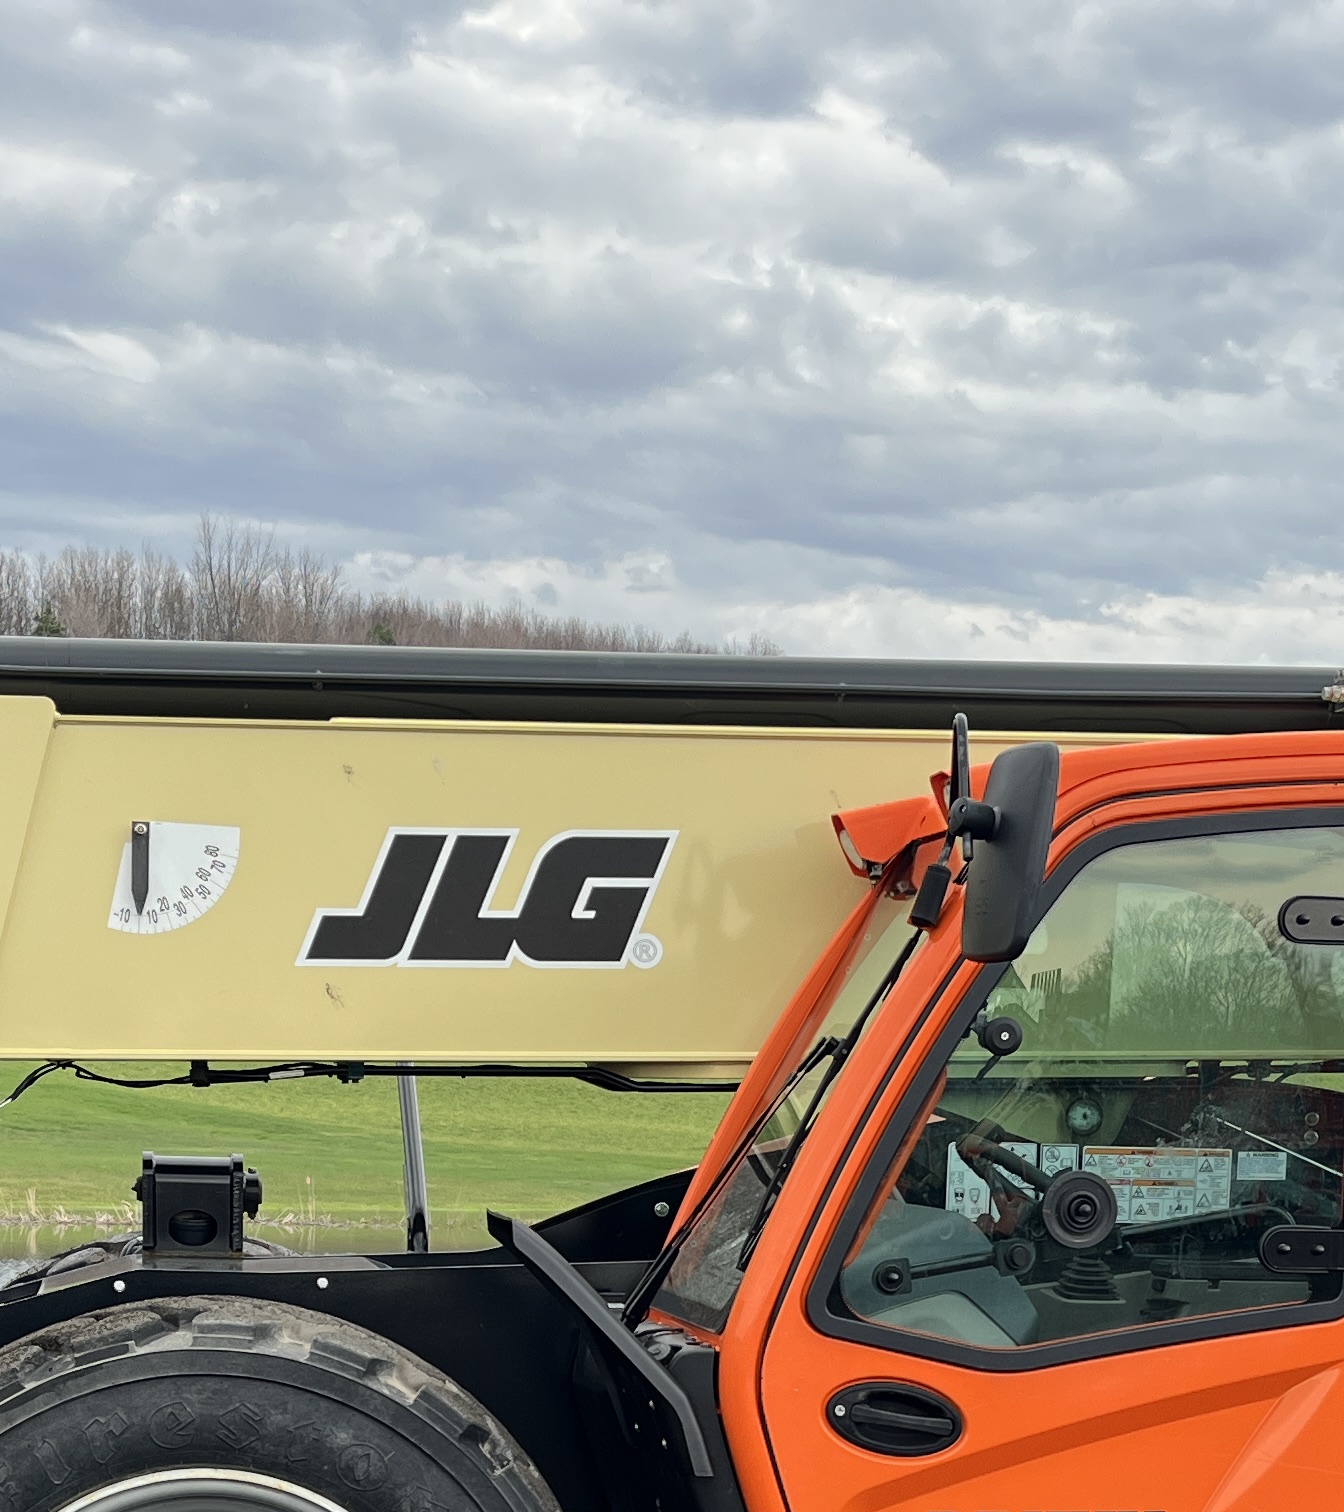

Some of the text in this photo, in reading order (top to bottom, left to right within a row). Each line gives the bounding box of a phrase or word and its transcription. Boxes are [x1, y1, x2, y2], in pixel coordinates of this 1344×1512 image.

[210, 860, 226, 873] 70
[195, 867, 211, 882] 60
[180, 885, 194, 900] 40
[195, 884, 211, 899] 50
[301, 831, 673, 965] JLG
[157, 896, 170, 912] 20
[173, 901, 187, 917] 30
[113, 908, 131, 923] -10
[146, 909, 158, 924] 10
